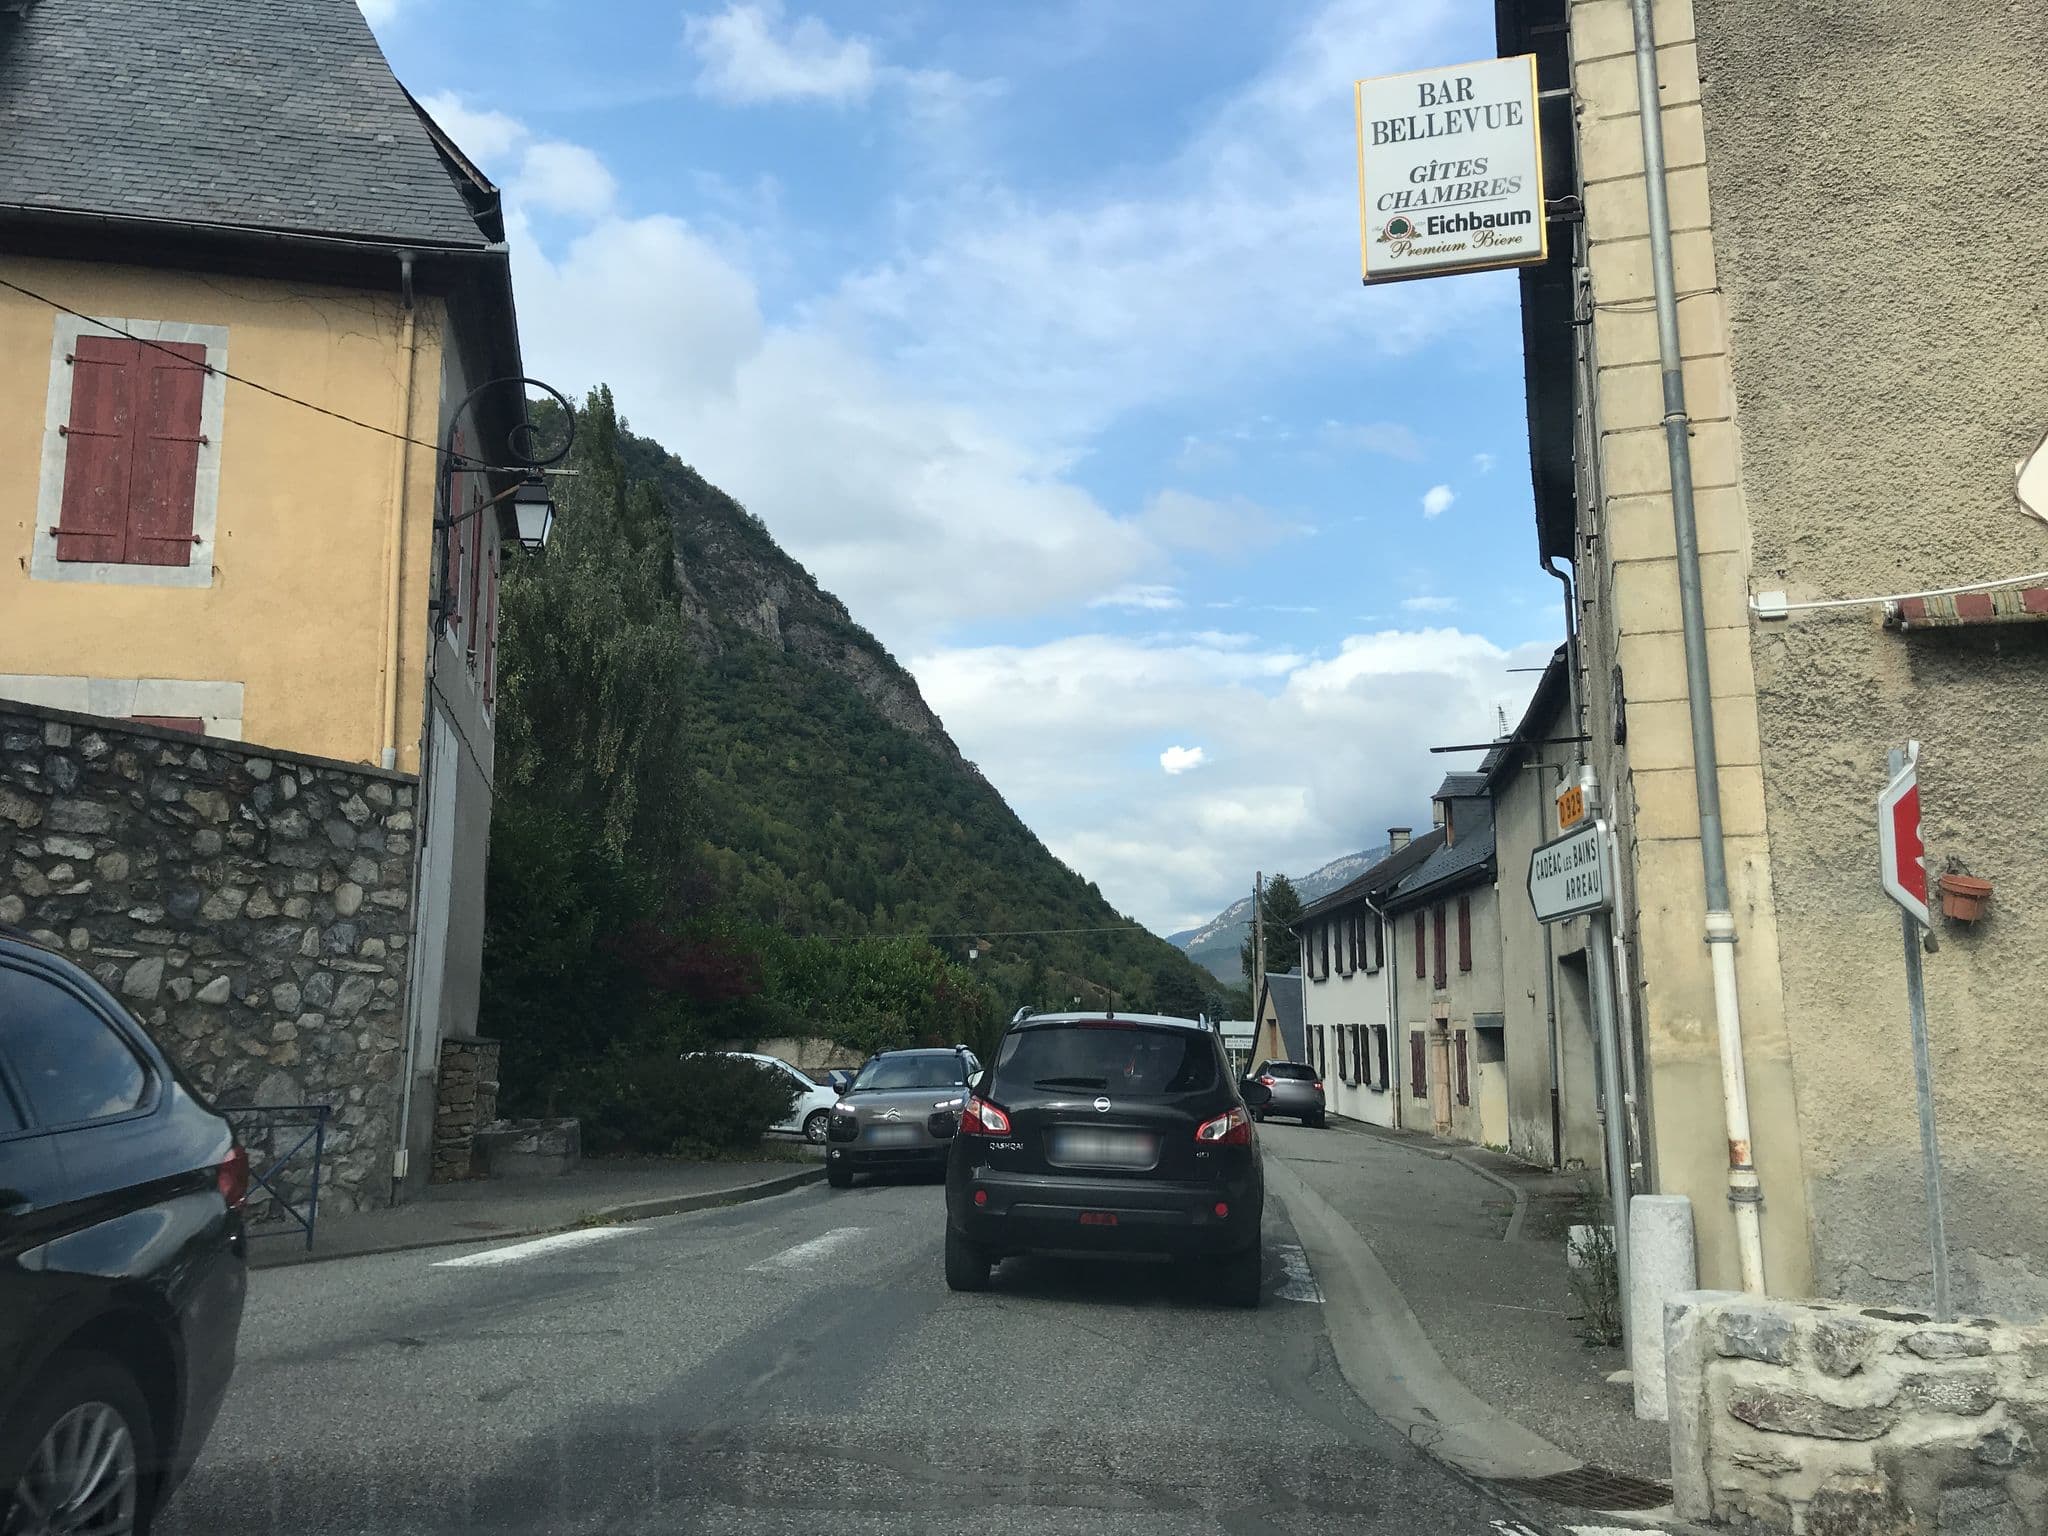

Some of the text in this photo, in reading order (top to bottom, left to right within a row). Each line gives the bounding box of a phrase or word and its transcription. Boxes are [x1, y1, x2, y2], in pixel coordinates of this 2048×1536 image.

[1418, 77, 1475, 108] BAR
[1371, 101, 1523, 146] BELLEVUE
[1409, 157, 1488, 184] GÎTES
[1377, 176, 1522, 212] CHAMBRES
[1427, 209, 1532, 236] Eichbaum
[1390, 230, 1523, 259] Premium Biere
[1566, 792, 1583, 819] 929
[1536, 852, 1562, 880] CADÉAC
[1573, 838, 1596, 867] BAINS
[1566, 870, 1599, 902] ARREAU
